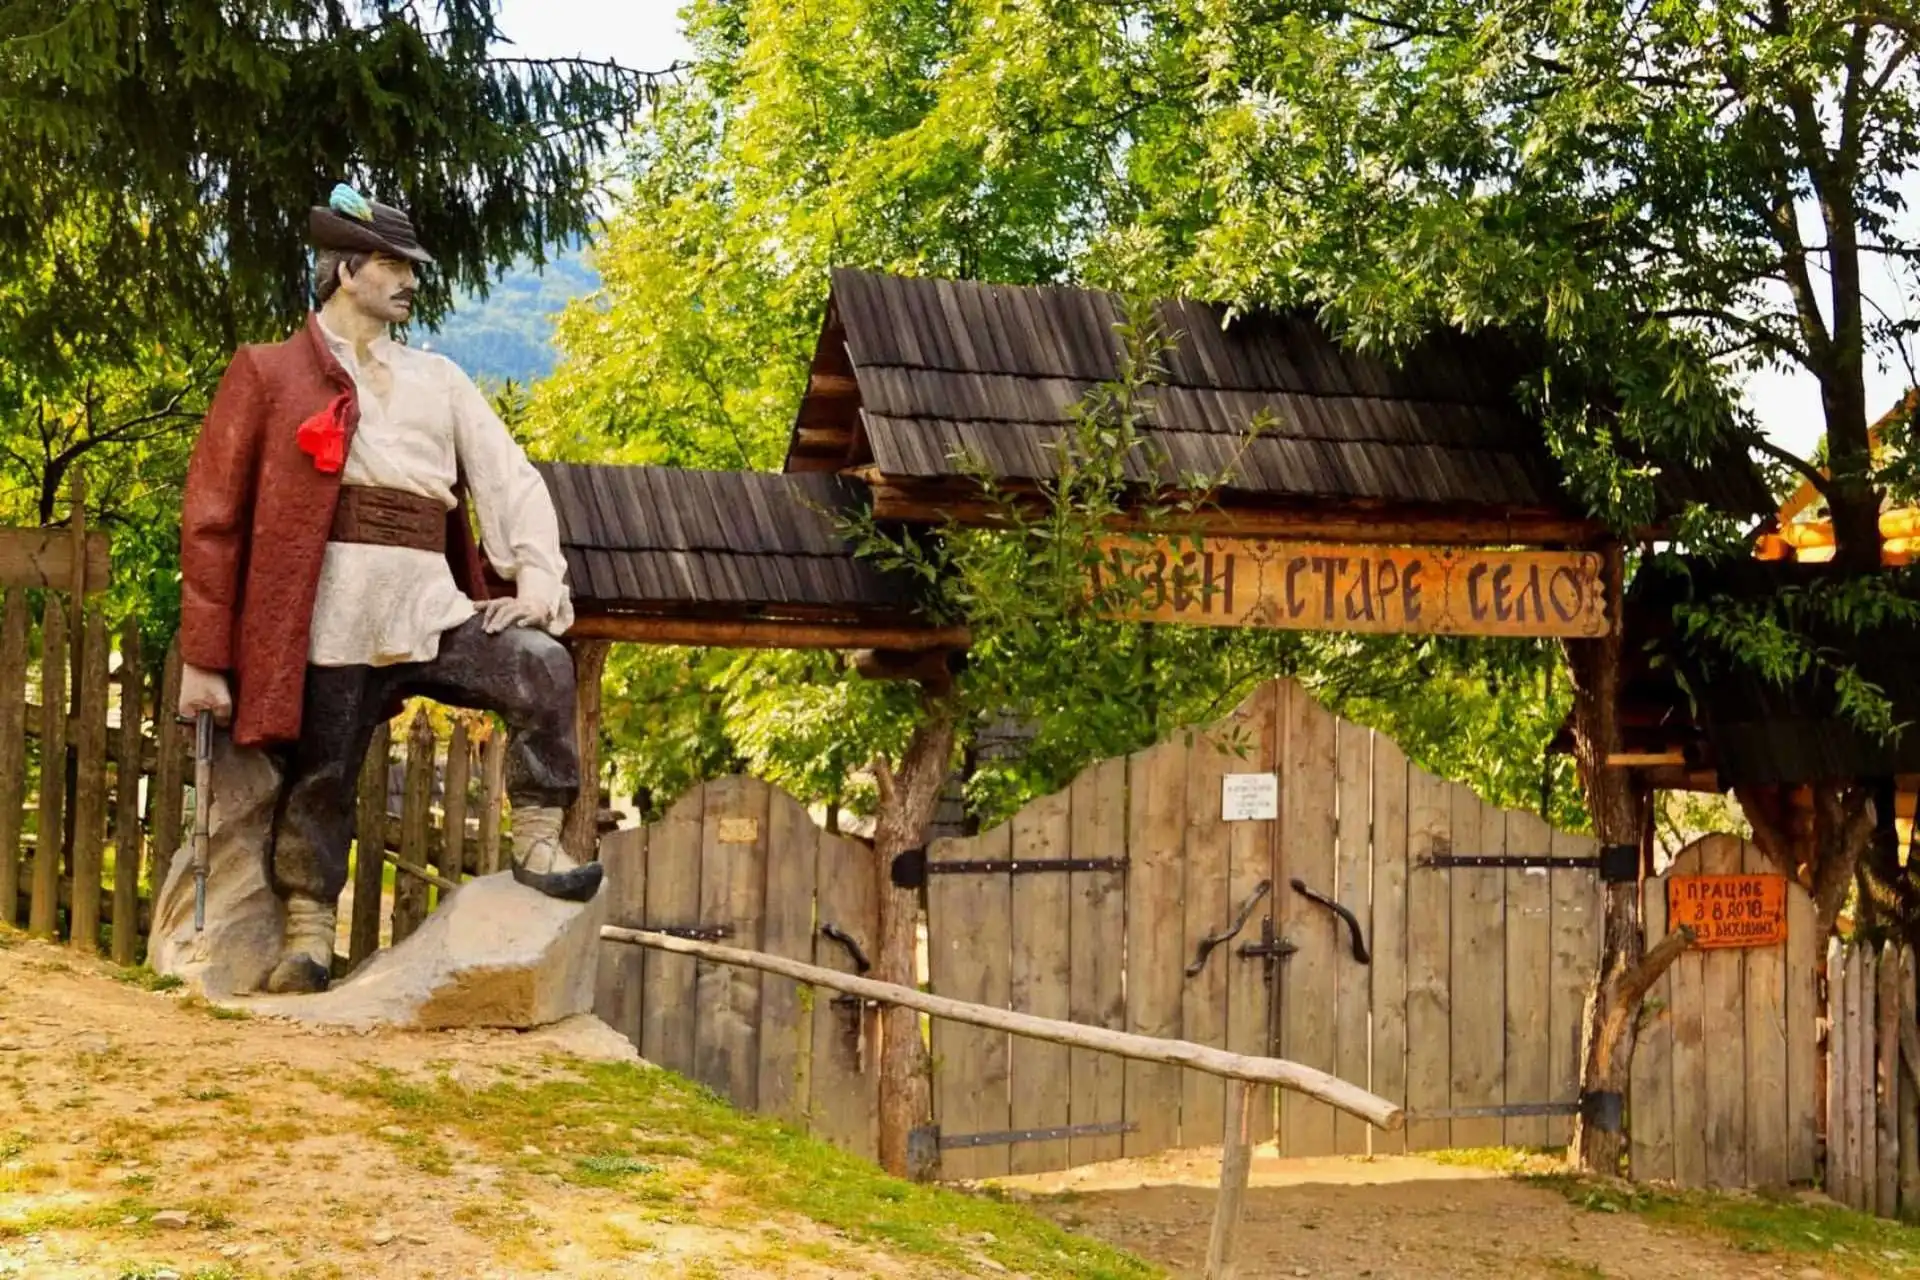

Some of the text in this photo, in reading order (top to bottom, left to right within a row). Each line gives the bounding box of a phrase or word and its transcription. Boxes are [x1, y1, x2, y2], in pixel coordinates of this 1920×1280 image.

[1082, 541, 1583, 623] ЗЕЙ СТАРЕ СЕЛО
[1687, 922, 1711, 939] ЕЗ
